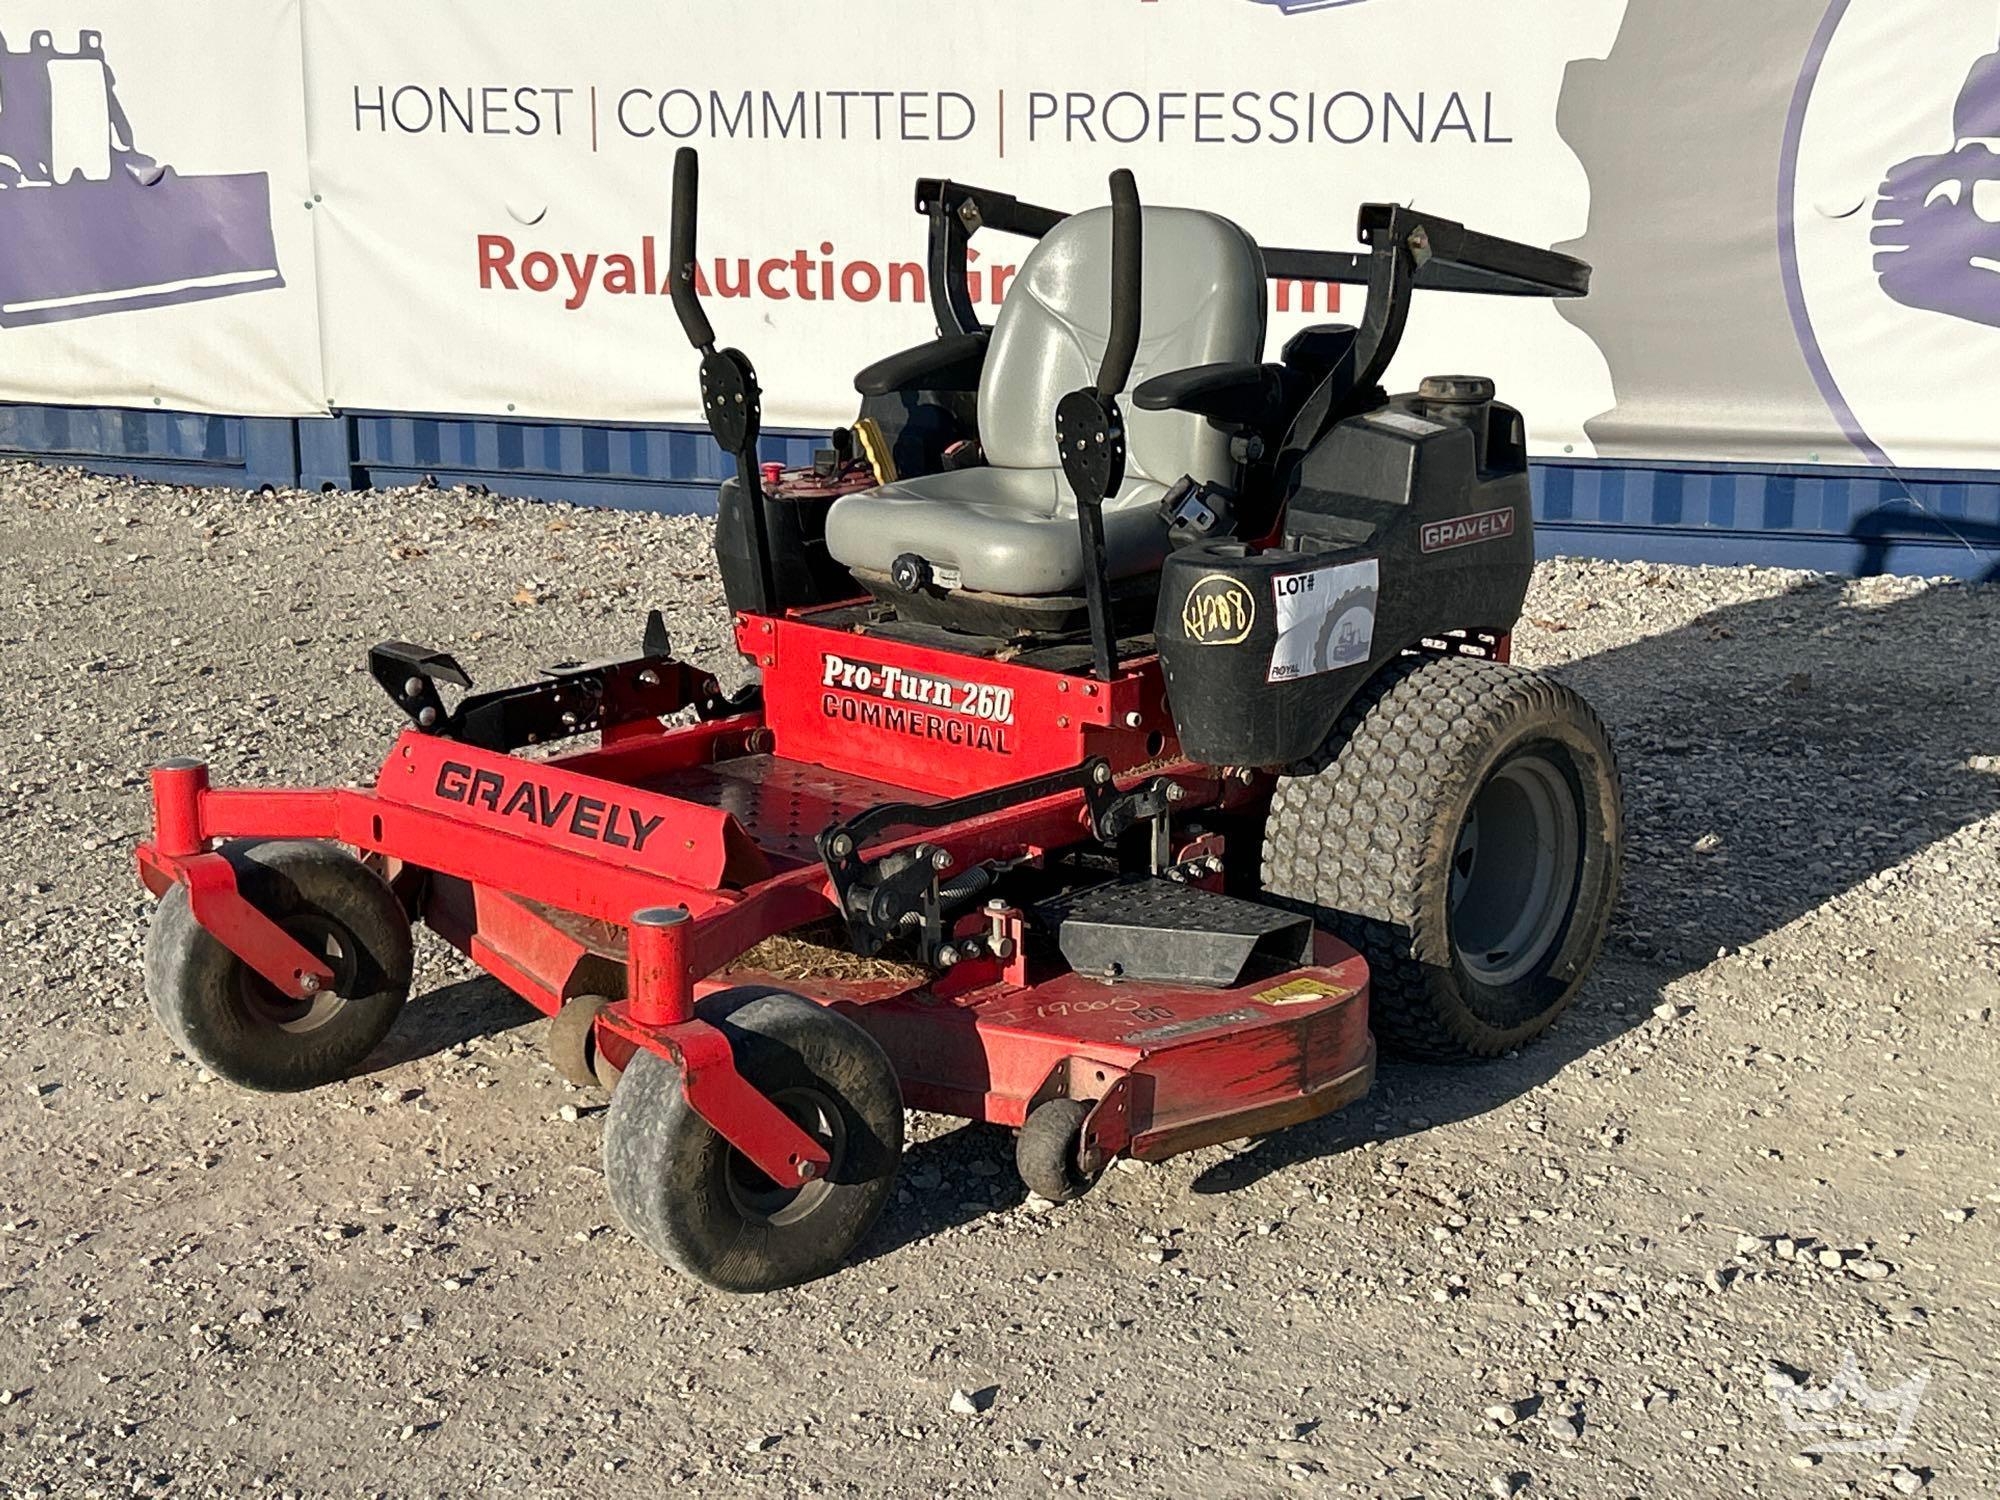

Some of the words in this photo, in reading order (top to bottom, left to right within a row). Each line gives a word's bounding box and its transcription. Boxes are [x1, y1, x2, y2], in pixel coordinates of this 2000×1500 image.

[354, 85, 574, 136] HONEST
[617, 88, 976, 141] COMMITTED
[1029, 91, 1513, 145] PROFESSIONAL
[1424, 512, 1511, 546] GRAVELY
[1277, 574, 1315, 597] LOT#
[823, 654, 952, 708] Pro-Turn
[959, 683, 1013, 722] 260
[1271, 663, 1300, 676] ROYAL
[823, 695, 1012, 754] COMMERCIAL
[435, 761, 665, 852] GRAVELY
